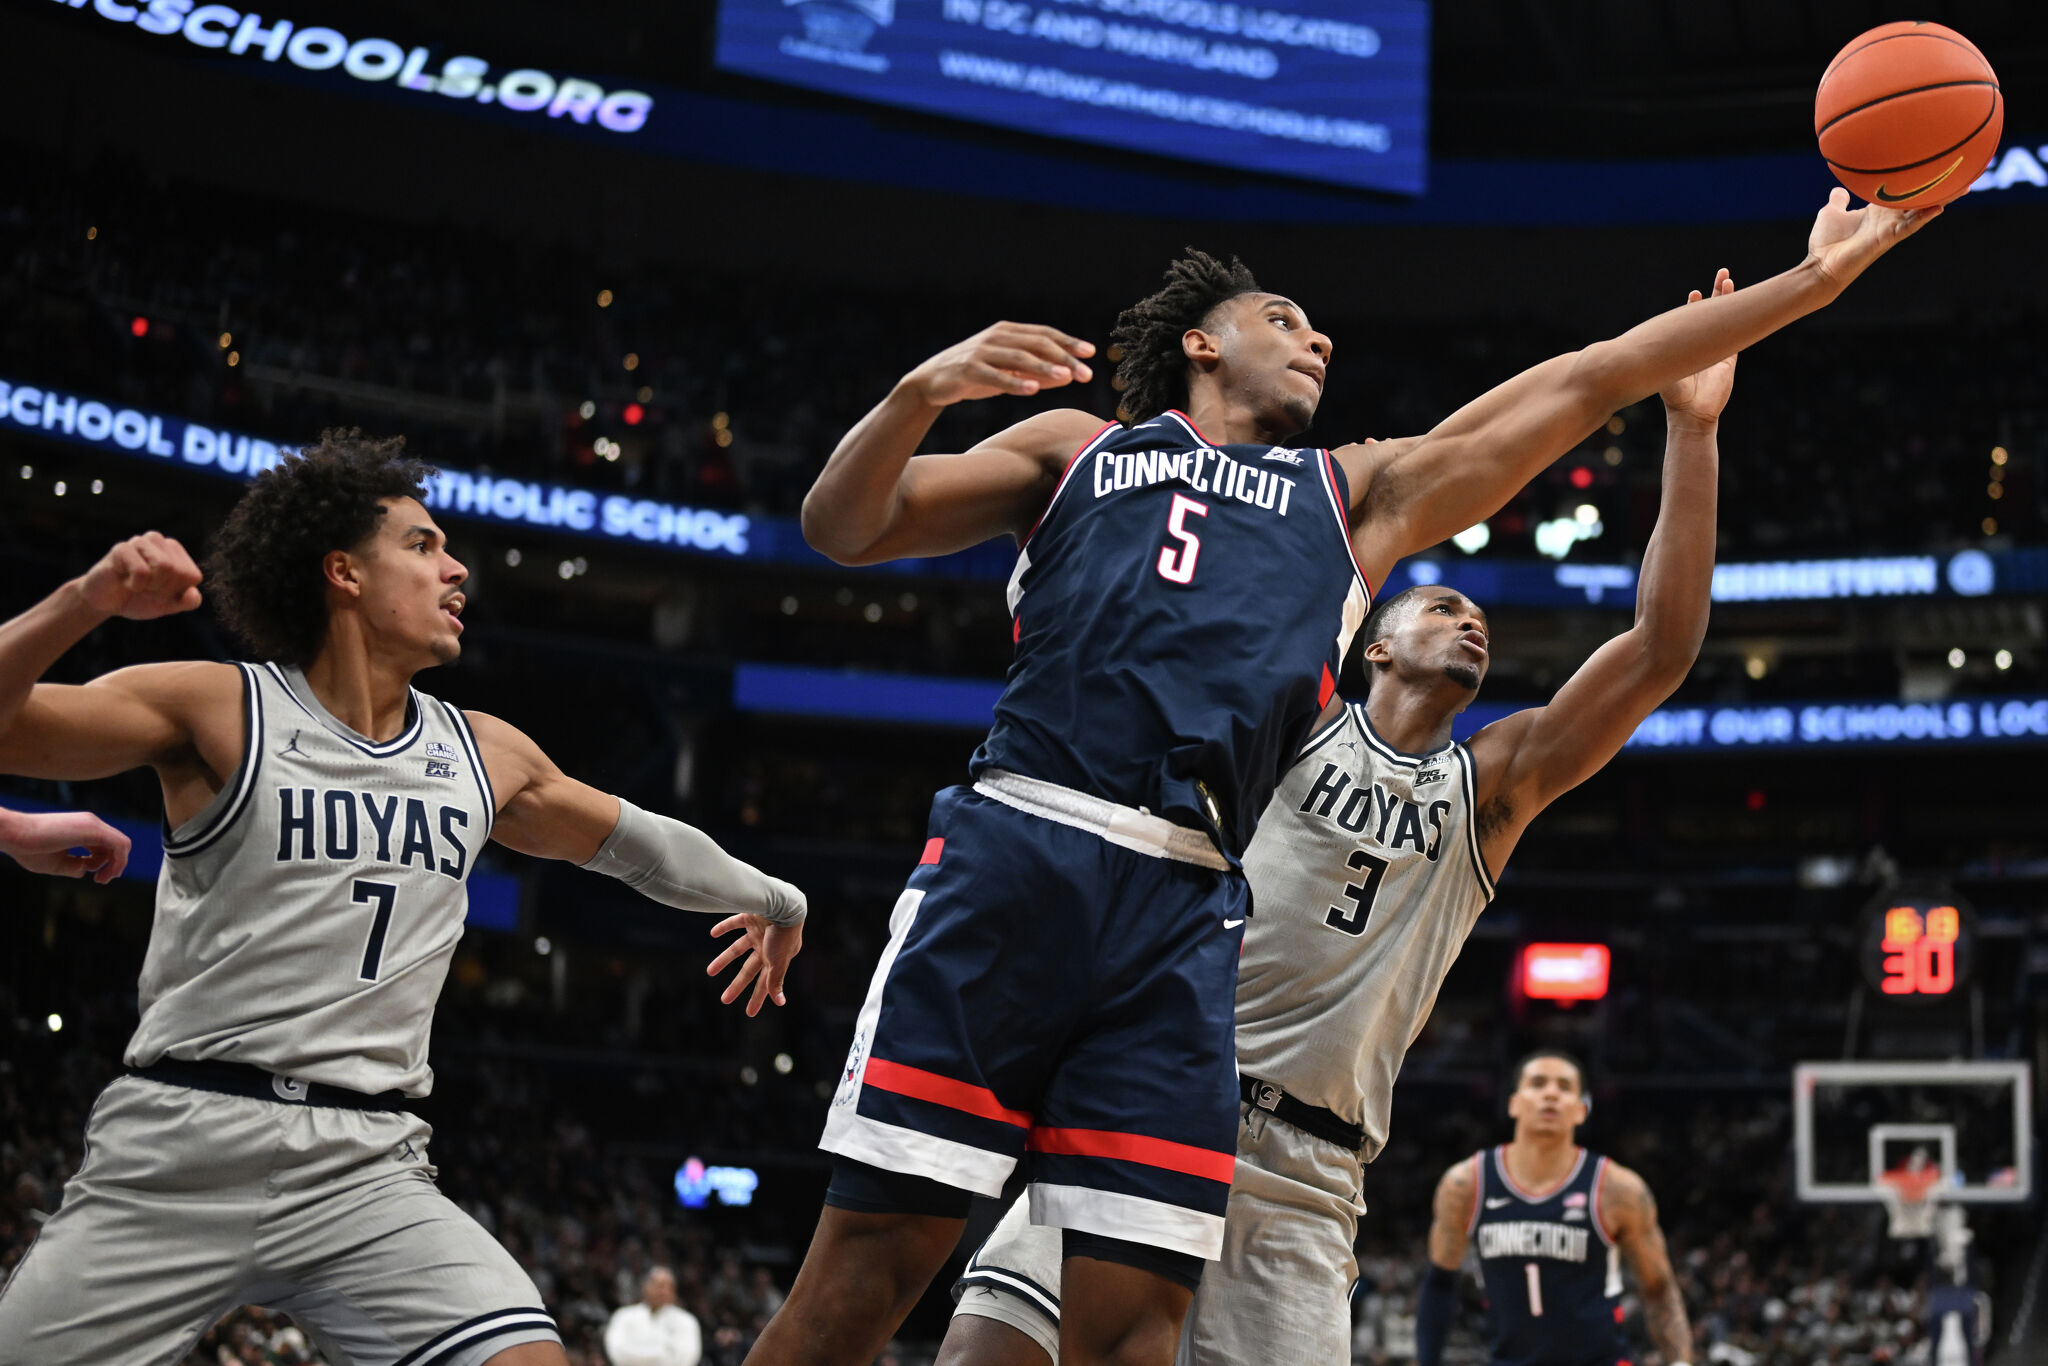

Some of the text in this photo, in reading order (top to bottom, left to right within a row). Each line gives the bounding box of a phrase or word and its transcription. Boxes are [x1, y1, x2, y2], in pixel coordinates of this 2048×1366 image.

[1032, 9, 1104, 48] AND
[0, 379, 175, 458] CHOOL
[1094, 448, 1296, 516] CONNECTICUT
[1157, 491, 1209, 585] 5
[1711, 707, 1794, 745] OUR
[1800, 702, 1972, 742] SCHOOLS
[425, 768, 457, 778] EAST
[427, 761, 450, 771] BIG
[1415, 774, 1448, 785] EAST
[1418, 769, 1441, 780] BIG
[276, 787, 469, 881] HOYAS
[1298, 761, 1452, 864] HOYAS
[1323, 849, 1392, 938] 3
[351, 878, 398, 984] 7
[1881, 937, 1954, 994] 30
[1479, 1221, 1589, 1263] CONNECTICUT
[1525, 1263, 1543, 1317] 1
